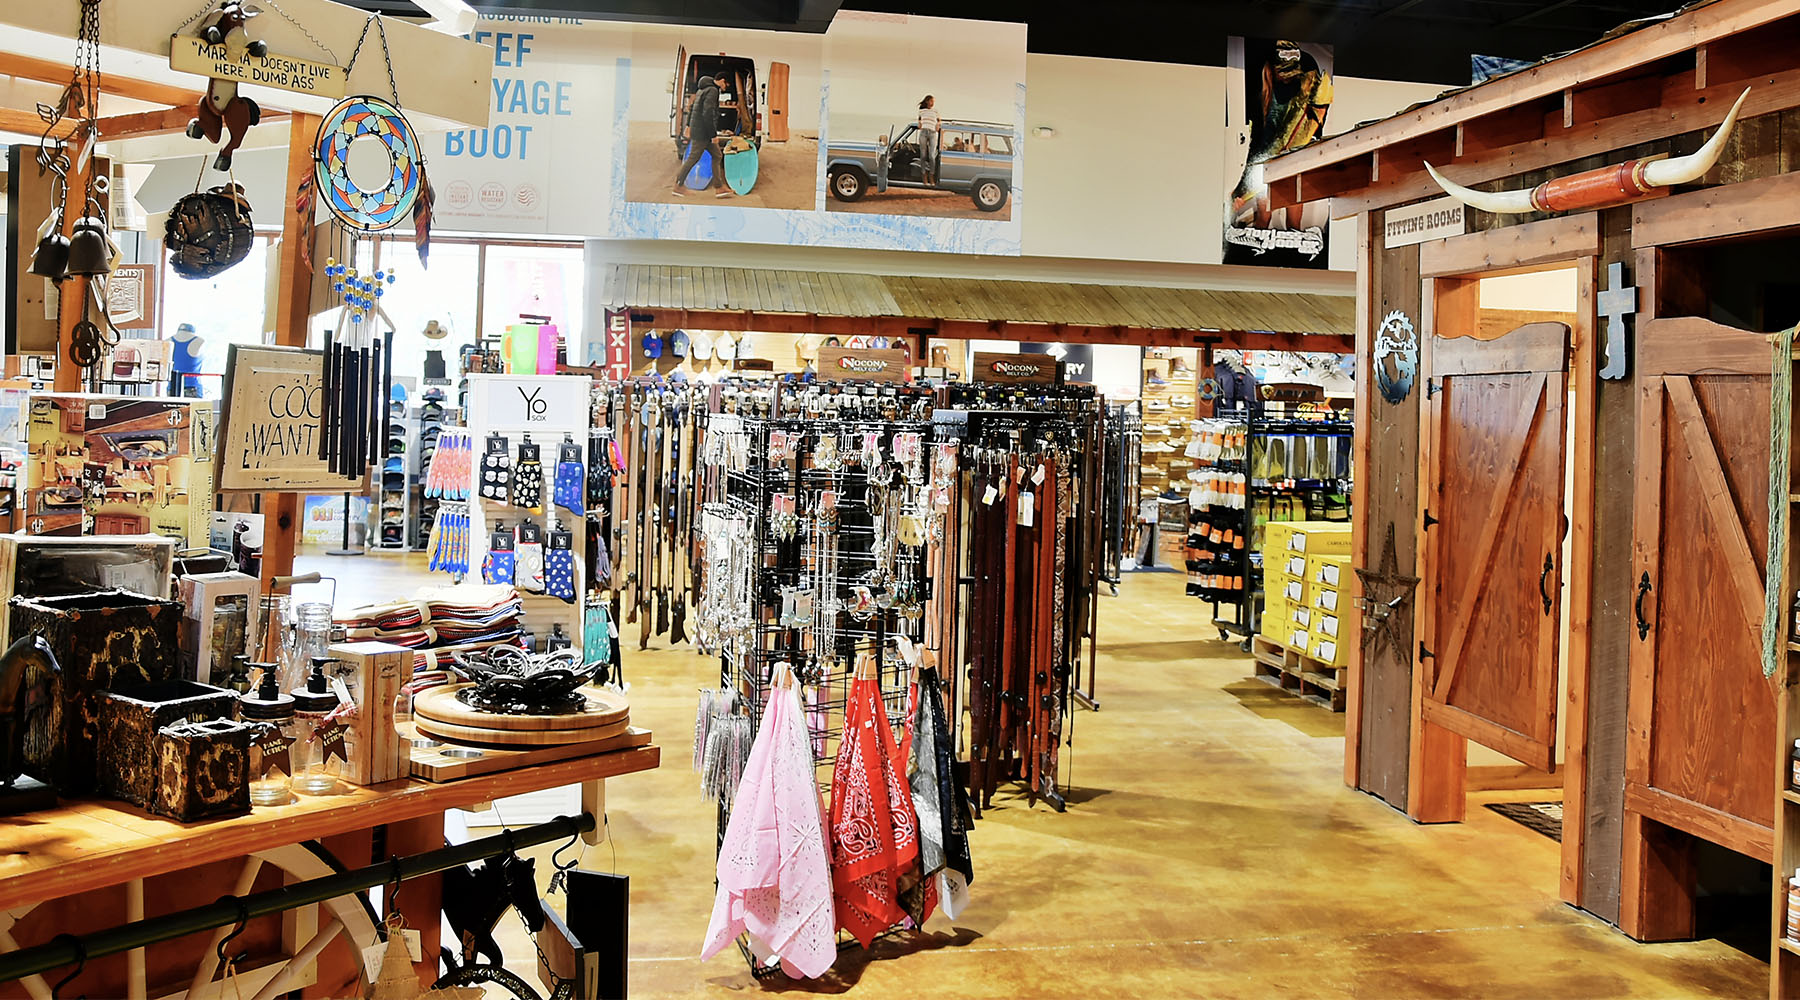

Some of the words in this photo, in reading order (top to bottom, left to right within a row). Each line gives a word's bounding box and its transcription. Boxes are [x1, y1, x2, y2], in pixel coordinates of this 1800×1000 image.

[191, 41, 251, 66] "MARA
[260, 56, 306, 74] DOESN'T
[309, 65, 330, 79] LIVE
[472, 31, 534, 67] EF
[252, 68, 288, 86] DUMB
[291, 76, 315, 90] ASS
[492, 78, 573, 116] YAGE
[1387, 215, 1424, 237] FITTING
[1427, 207, 1462, 230] ROOMS
[610, 315, 628, 381] EXIT
[517, 386, 547, 421] Yo
[252, 423, 319, 457] WANT
[263, 738, 284, 749] HAND
[323, 727, 340, 739] HAND
[323, 732, 345, 747] LOTION
[262, 745, 288, 757] LOTION
